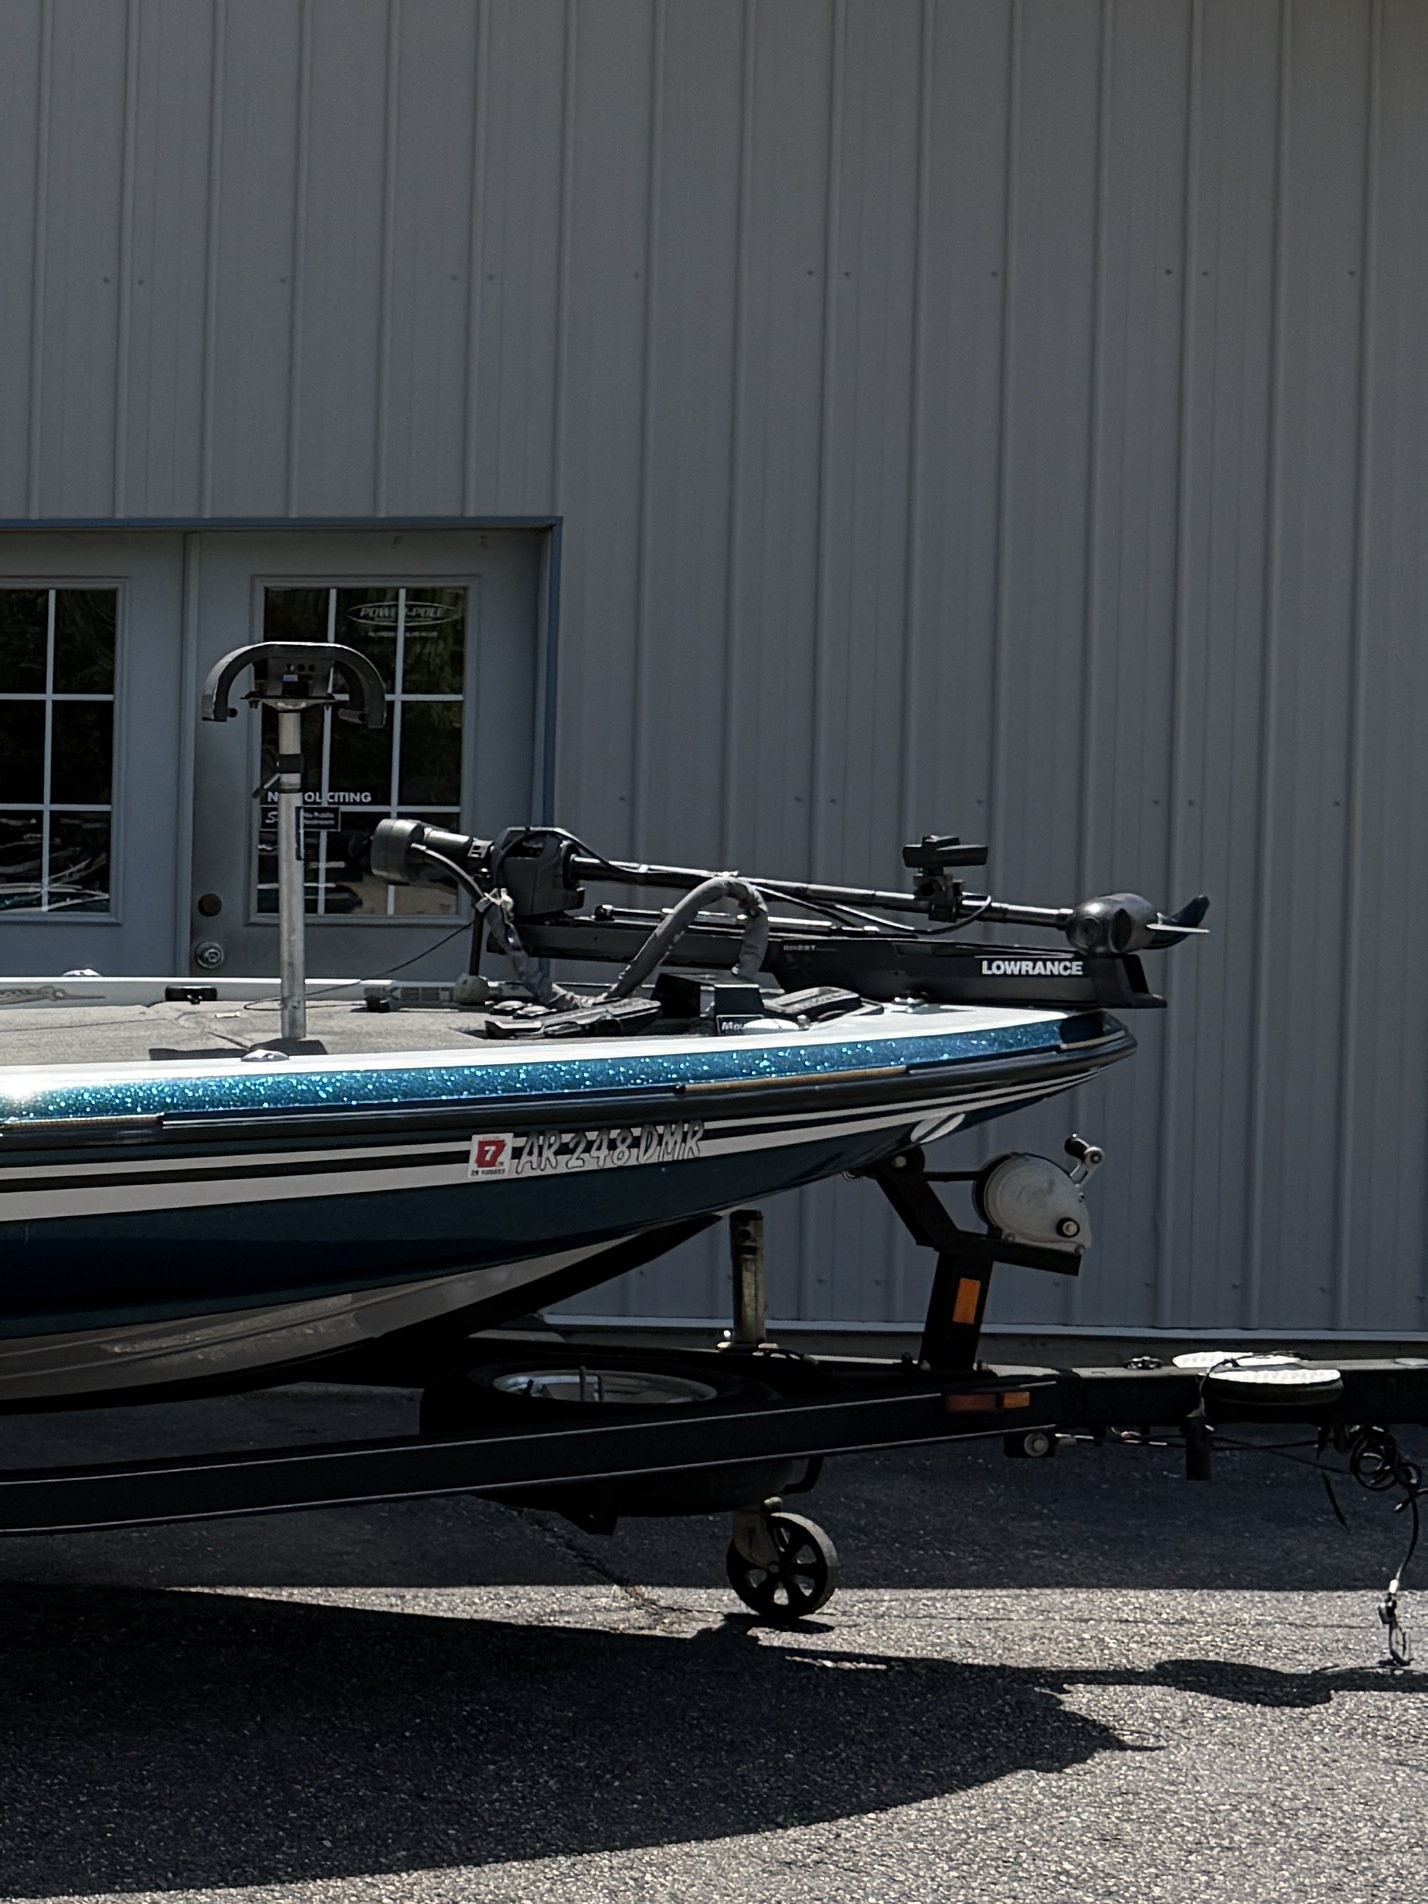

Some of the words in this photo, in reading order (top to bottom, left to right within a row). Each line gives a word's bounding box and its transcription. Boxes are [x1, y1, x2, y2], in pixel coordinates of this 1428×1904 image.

[981, 960, 1084, 976] LOWRANCE
[483, 1145, 497, 1162] 7
[565, 1127, 634, 1170] 248
